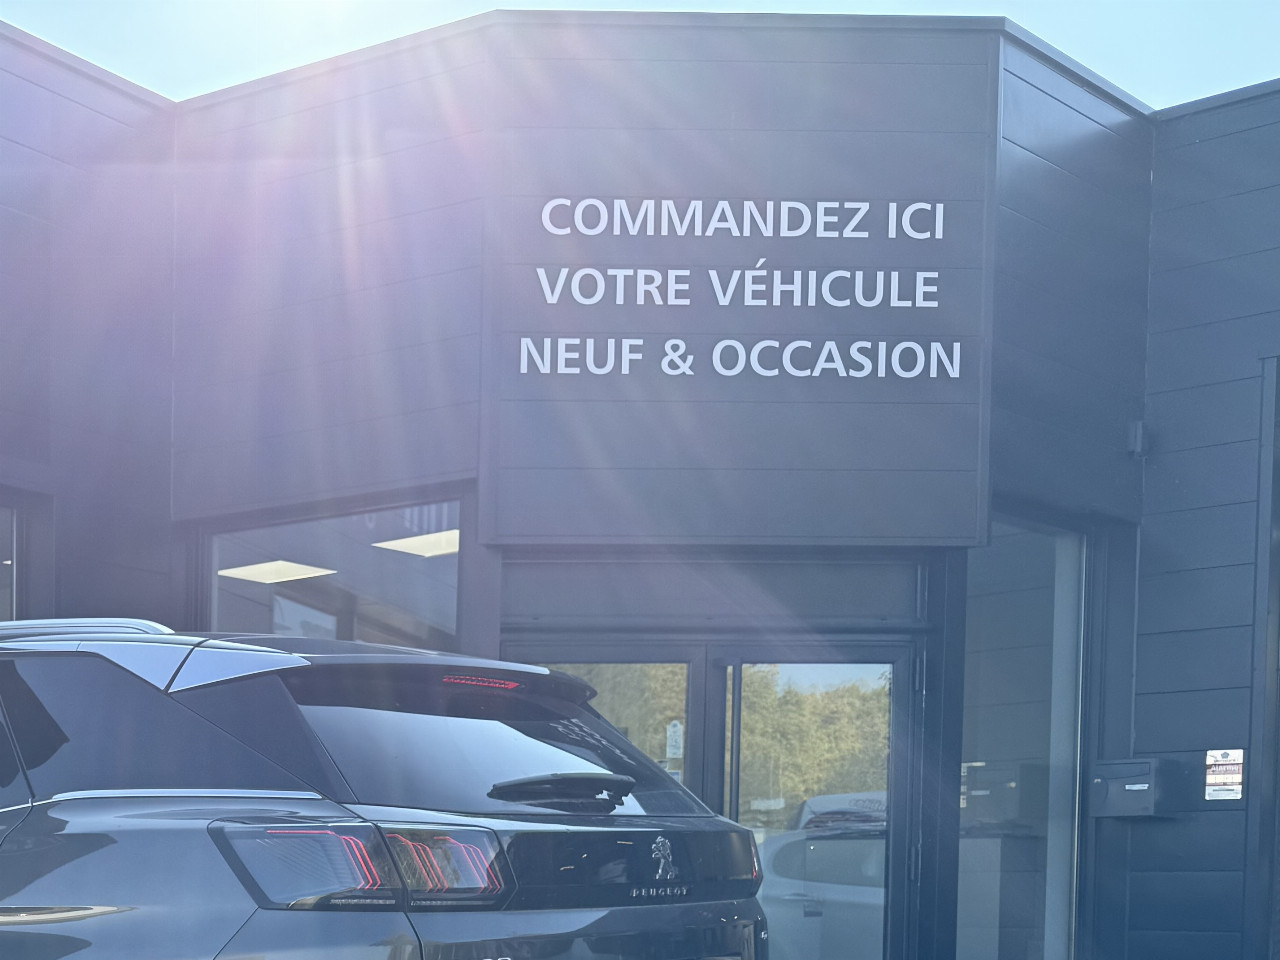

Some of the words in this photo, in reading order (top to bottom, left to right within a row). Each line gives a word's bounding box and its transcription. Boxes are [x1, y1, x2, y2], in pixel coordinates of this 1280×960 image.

[541, 198, 869, 238] COMMANDEZ
[888, 202, 945, 239] ICI
[536, 267, 691, 306] VOTRE
[708, 258, 939, 308] VÉHICULE
[520, 337, 644, 375] NEUF
[660, 338, 695, 376] &
[712, 339, 961, 378] OCCASION
[630, 885, 689, 897] PEUGEOT
